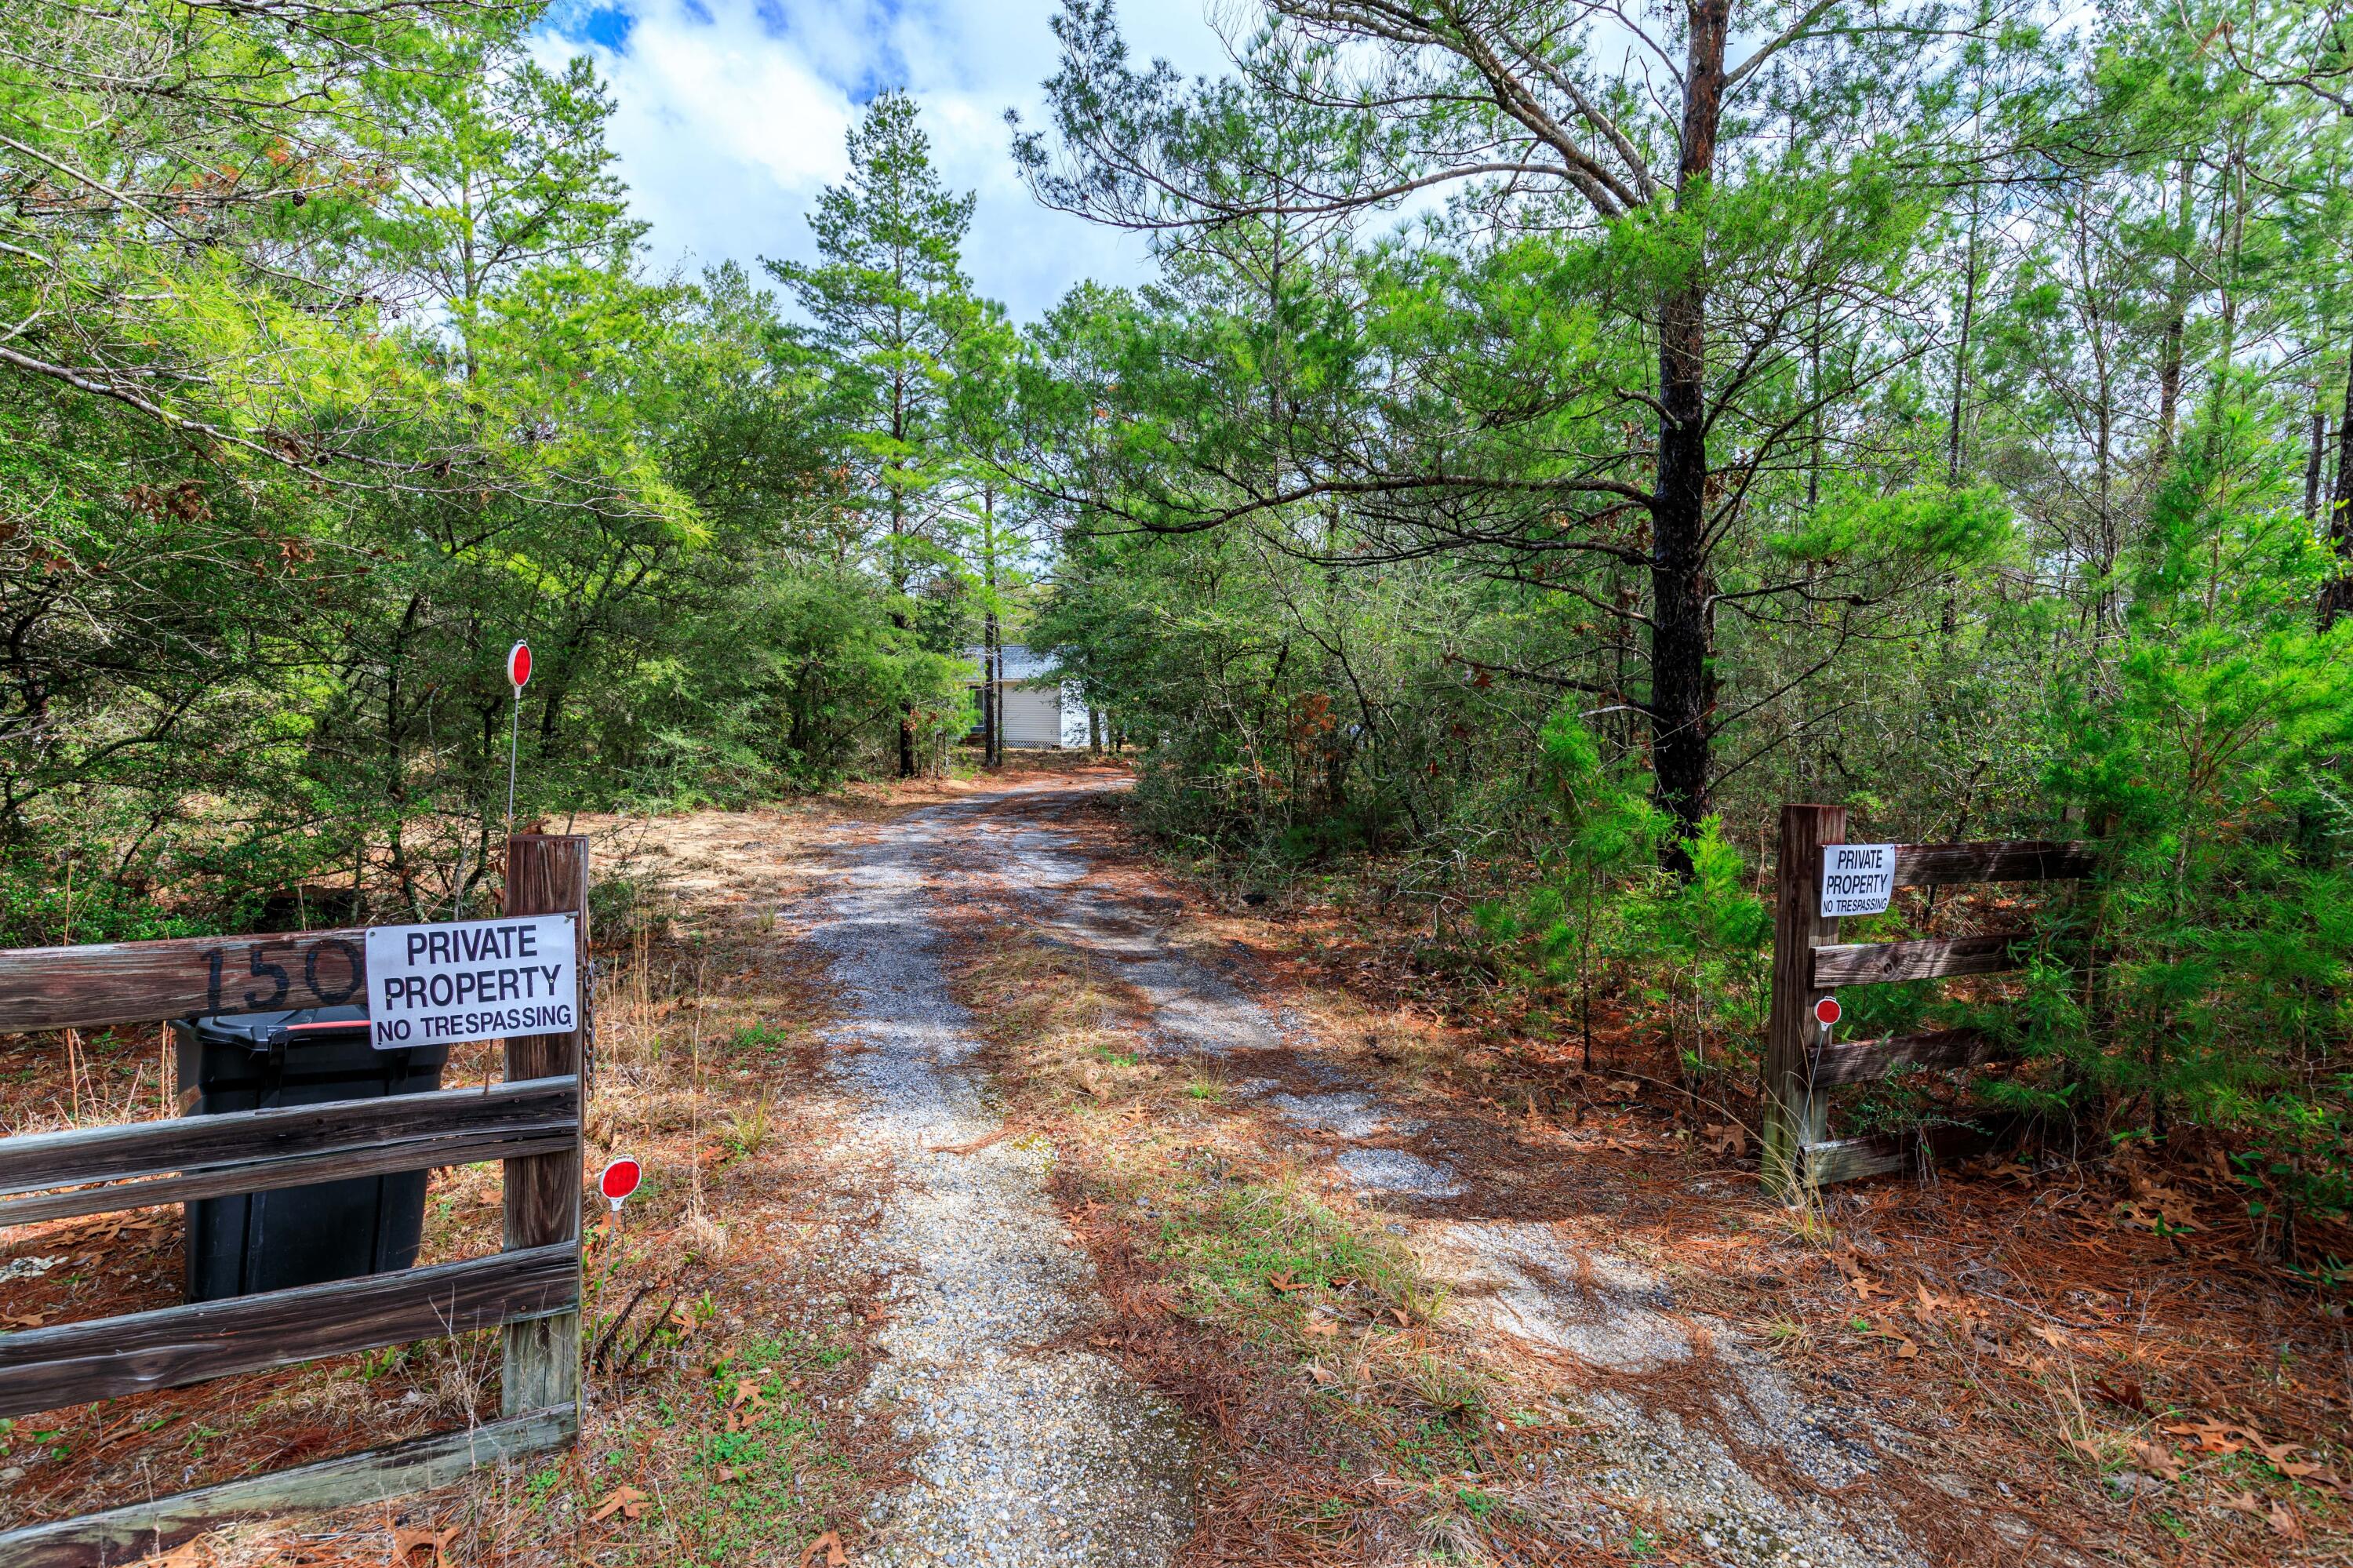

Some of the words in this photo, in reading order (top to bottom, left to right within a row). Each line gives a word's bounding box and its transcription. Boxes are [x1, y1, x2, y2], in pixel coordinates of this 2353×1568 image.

[1838, 849, 1882, 869] PRIVATE
[1827, 874, 1888, 894] PROPERTY
[1823, 900, 1833, 913] NO
[1837, 898, 1887, 911] TRESPASSING
[406, 925, 537, 966] PRIVATE
[187, 940, 362, 1017] 150
[384, 964, 561, 1011] PROPERTY
[376, 1018, 412, 1042] NO
[420, 1004, 571, 1038] TRESPASSING
